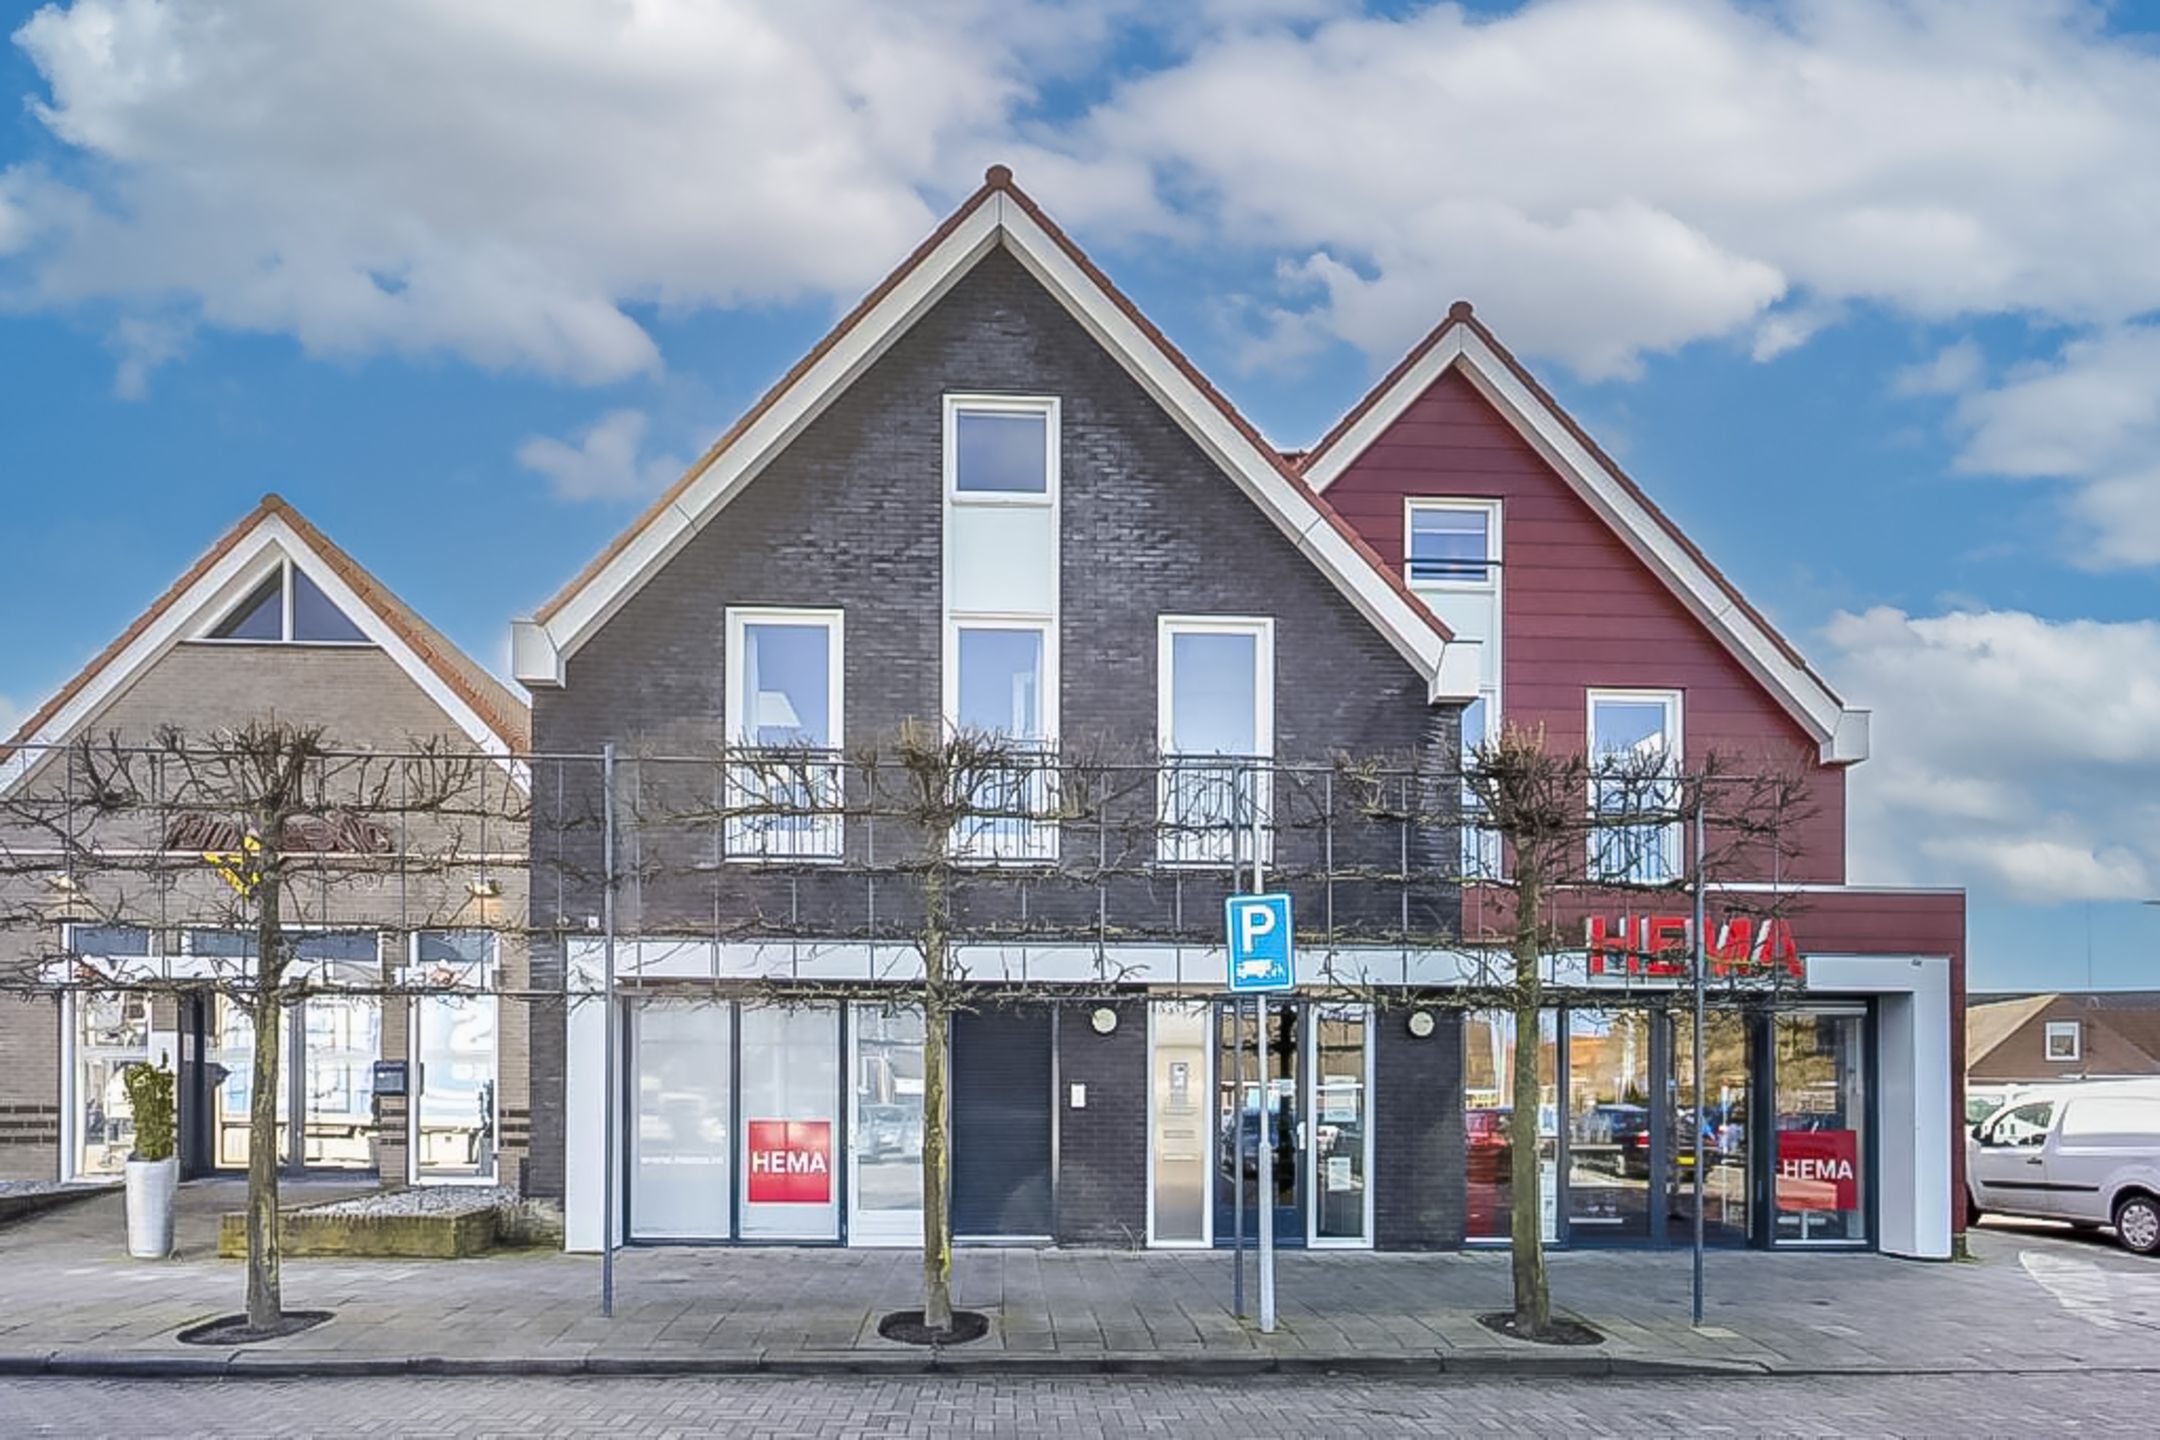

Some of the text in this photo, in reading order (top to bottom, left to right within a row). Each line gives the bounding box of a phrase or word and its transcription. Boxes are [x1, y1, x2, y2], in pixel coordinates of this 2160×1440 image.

[1241, 904, 1276, 953] P
[1586, 914, 1804, 977] HEMA
[751, 1150, 828, 1174] HEMA
[1782, 1158, 1854, 1180] HEMA
